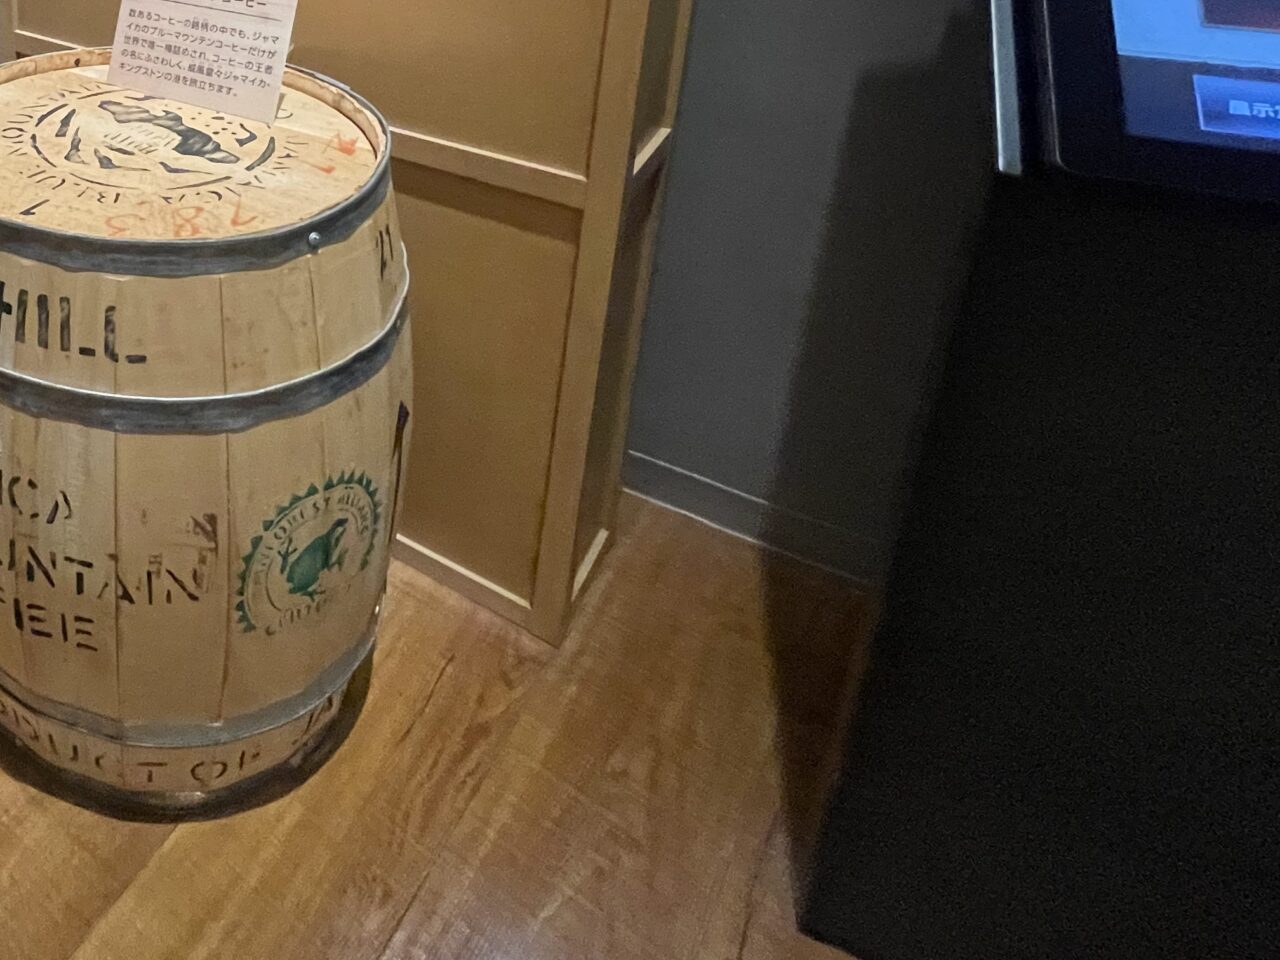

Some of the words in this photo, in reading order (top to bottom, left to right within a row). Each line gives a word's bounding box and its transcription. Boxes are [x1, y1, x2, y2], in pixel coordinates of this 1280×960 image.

[125, 21, 277, 59] イカのブルーマウンテンコーヒーだけが
